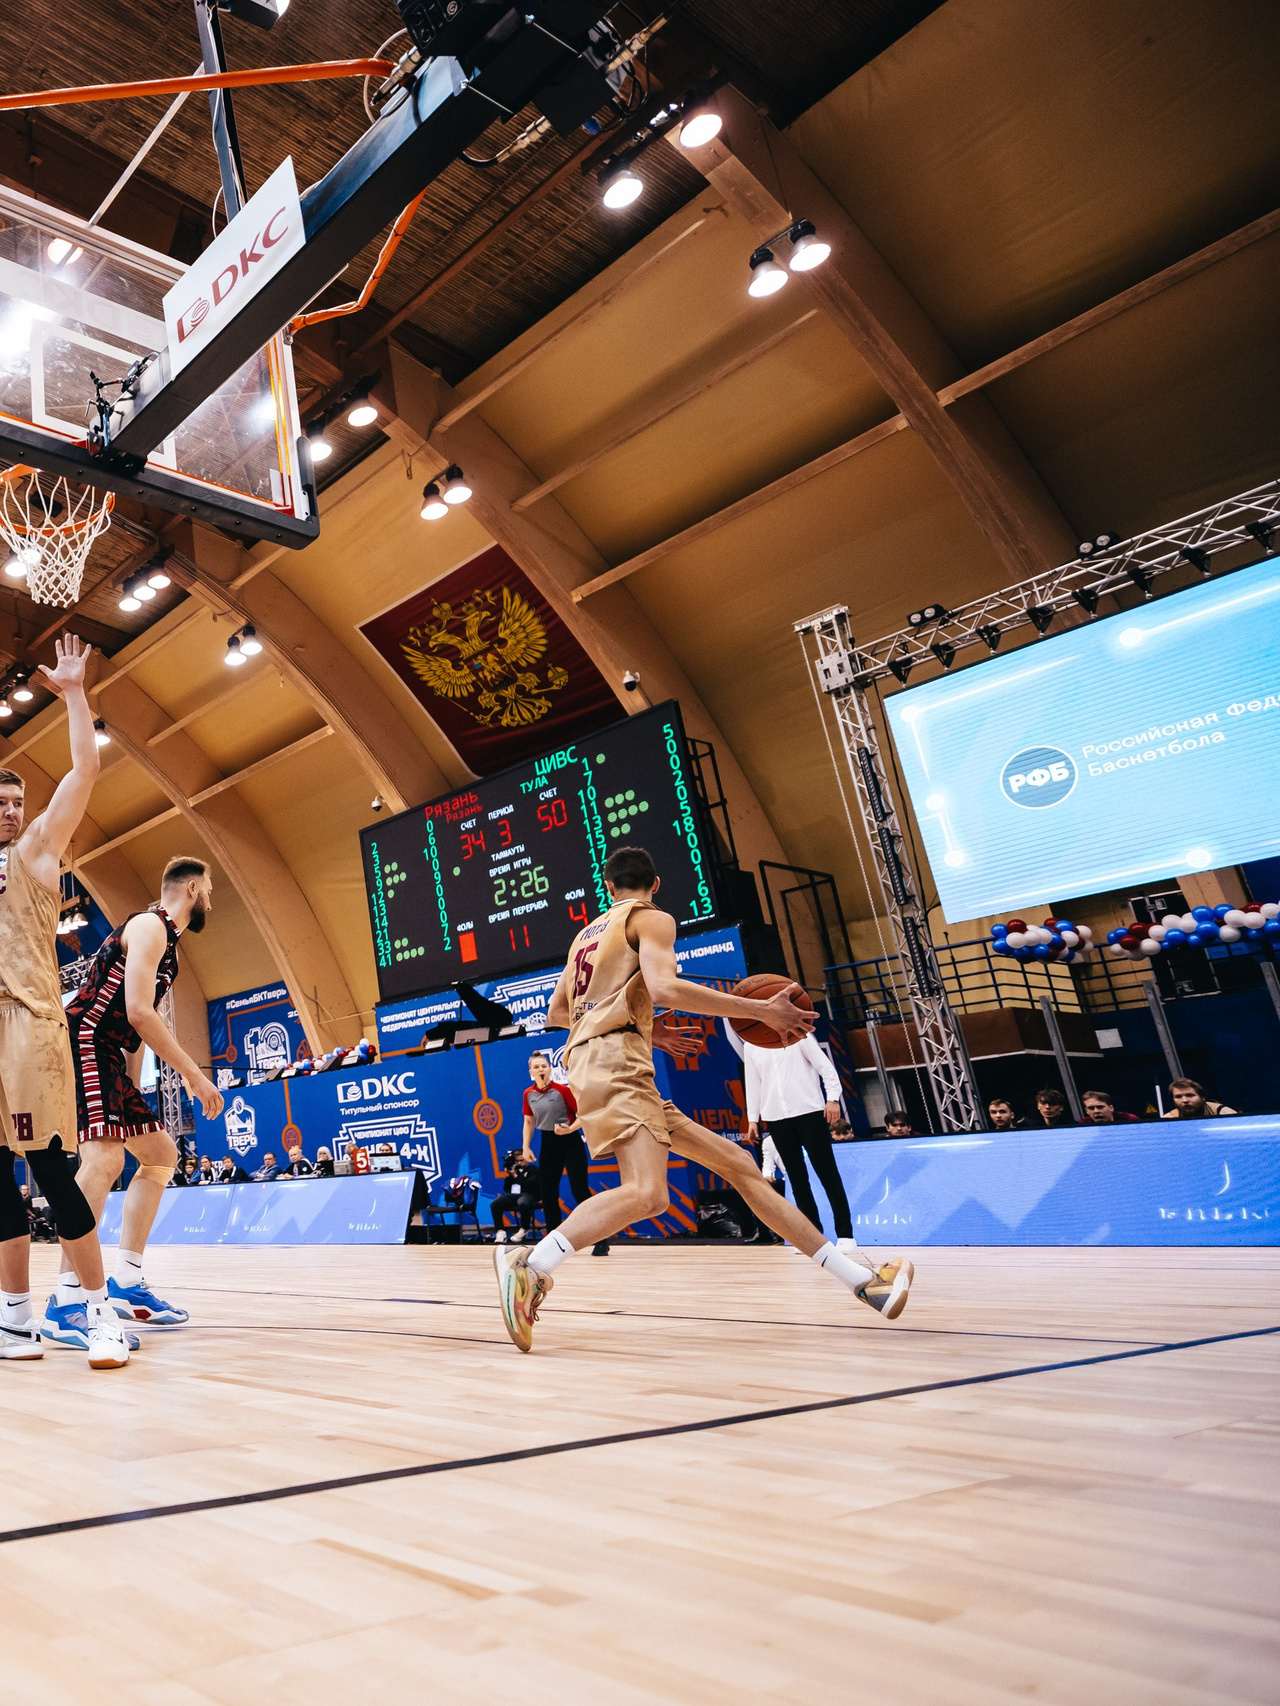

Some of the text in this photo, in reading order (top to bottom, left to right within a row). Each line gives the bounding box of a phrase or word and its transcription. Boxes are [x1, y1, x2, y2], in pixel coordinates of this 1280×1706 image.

[211, 206, 289, 307] DKC
[663, 723, 674, 740] 5
[1082, 712, 1219, 759] Российская
[666, 739, 677, 754] 0
[1087, 730, 1227, 777] Баскетбола
[534, 745, 578, 776] ЦИВС
[582, 757, 589, 771] 1
[670, 754, 680, 770] 0
[520, 775, 548, 794] ТУЛА
[583, 770, 593, 786] 7
[672, 770, 684, 786] 2
[1007, 761, 1070, 793] РФБ
[539, 787, 558, 801] СЧЕТ
[578, 785, 596, 804] 10
[676, 785, 687, 801] 0
[424, 792, 478, 820] Рязань
[446, 804, 483, 824] Рязань
[488, 804, 514, 820] ПЕРИОД
[580, 801, 597, 818] 11
[680, 800, 691, 817] 5
[536, 799, 568, 832] 50
[426, 820, 434, 833] 0
[460, 818, 477, 831] СЧЕТ
[583, 815, 602, 833] 13
[672, 816, 695, 836] 18
[428, 833, 436, 845] 6
[497, 819, 512, 847] 3
[586, 830, 605, 847] 15
[687, 832, 698, 848] 0
[371, 842, 378, 855] 2
[459, 830, 486, 860] 34
[589, 844, 607, 862] 17
[372, 854, 380, 867] 3
[423, 846, 437, 861] 10
[690, 848, 701, 864] 0
[374, 867, 382, 879] 5
[432, 858, 440, 872] 0
[489, 856, 532, 878] ВРЕМЯ ИГРЫ
[694, 864, 703, 880] 1
[376, 879, 383, 891] 9
[433, 871, 441, 884] 9
[493, 865, 550, 906] 2:26
[436, 884, 444, 897] 0
[565, 888, 585, 901] ФОЛЫ
[697, 880, 709, 897] 6
[371, 891, 384, 905] 12
[438, 896, 446, 910] 0
[372, 903, 387, 917] 13
[488, 899, 549, 924] ВРЕМЯ ПЕРЕРЫВА
[568, 902, 590, 927] 4
[689, 897, 713, 917] 13
[375, 916, 389, 930] 14
[440, 910, 447, 924] 0
[441, 923, 449, 937] 7
[456, 921, 474, 932] ФОЛЫ
[376, 928, 389, 944] 21
[444, 937, 452, 951] 2
[509, 924, 530, 951] 11
[377, 940, 392, 956] 33
[690, 941, 735, 959] КОМАНД
[379, 954, 392, 968] 41
[573, 941, 599, 1000] 15
[226, 988, 287, 1010] #СемьяБКТверь
[507, 985, 541, 998] ЧЕМПИОНАТ
[505, 995, 546, 1015] ИНАЛ
[380, 1010, 417, 1024] ЧЕМПИОНАТ
[381, 1011, 457, 1033] ФЕДЕРАЛЬНОГО ОКРУГА
[362, 1071, 417, 1100] DKC
[340, 1099, 420, 1116] Титульный спонсор
[693, 1109, 740, 1130] ЦЕЛЬ
[354, 1126, 409, 1139] ЧЕМПИОНАТ ЦФО
[227, 1135, 258, 1150] ТВЕРЬ
[356, 1152, 368, 1169] 5
